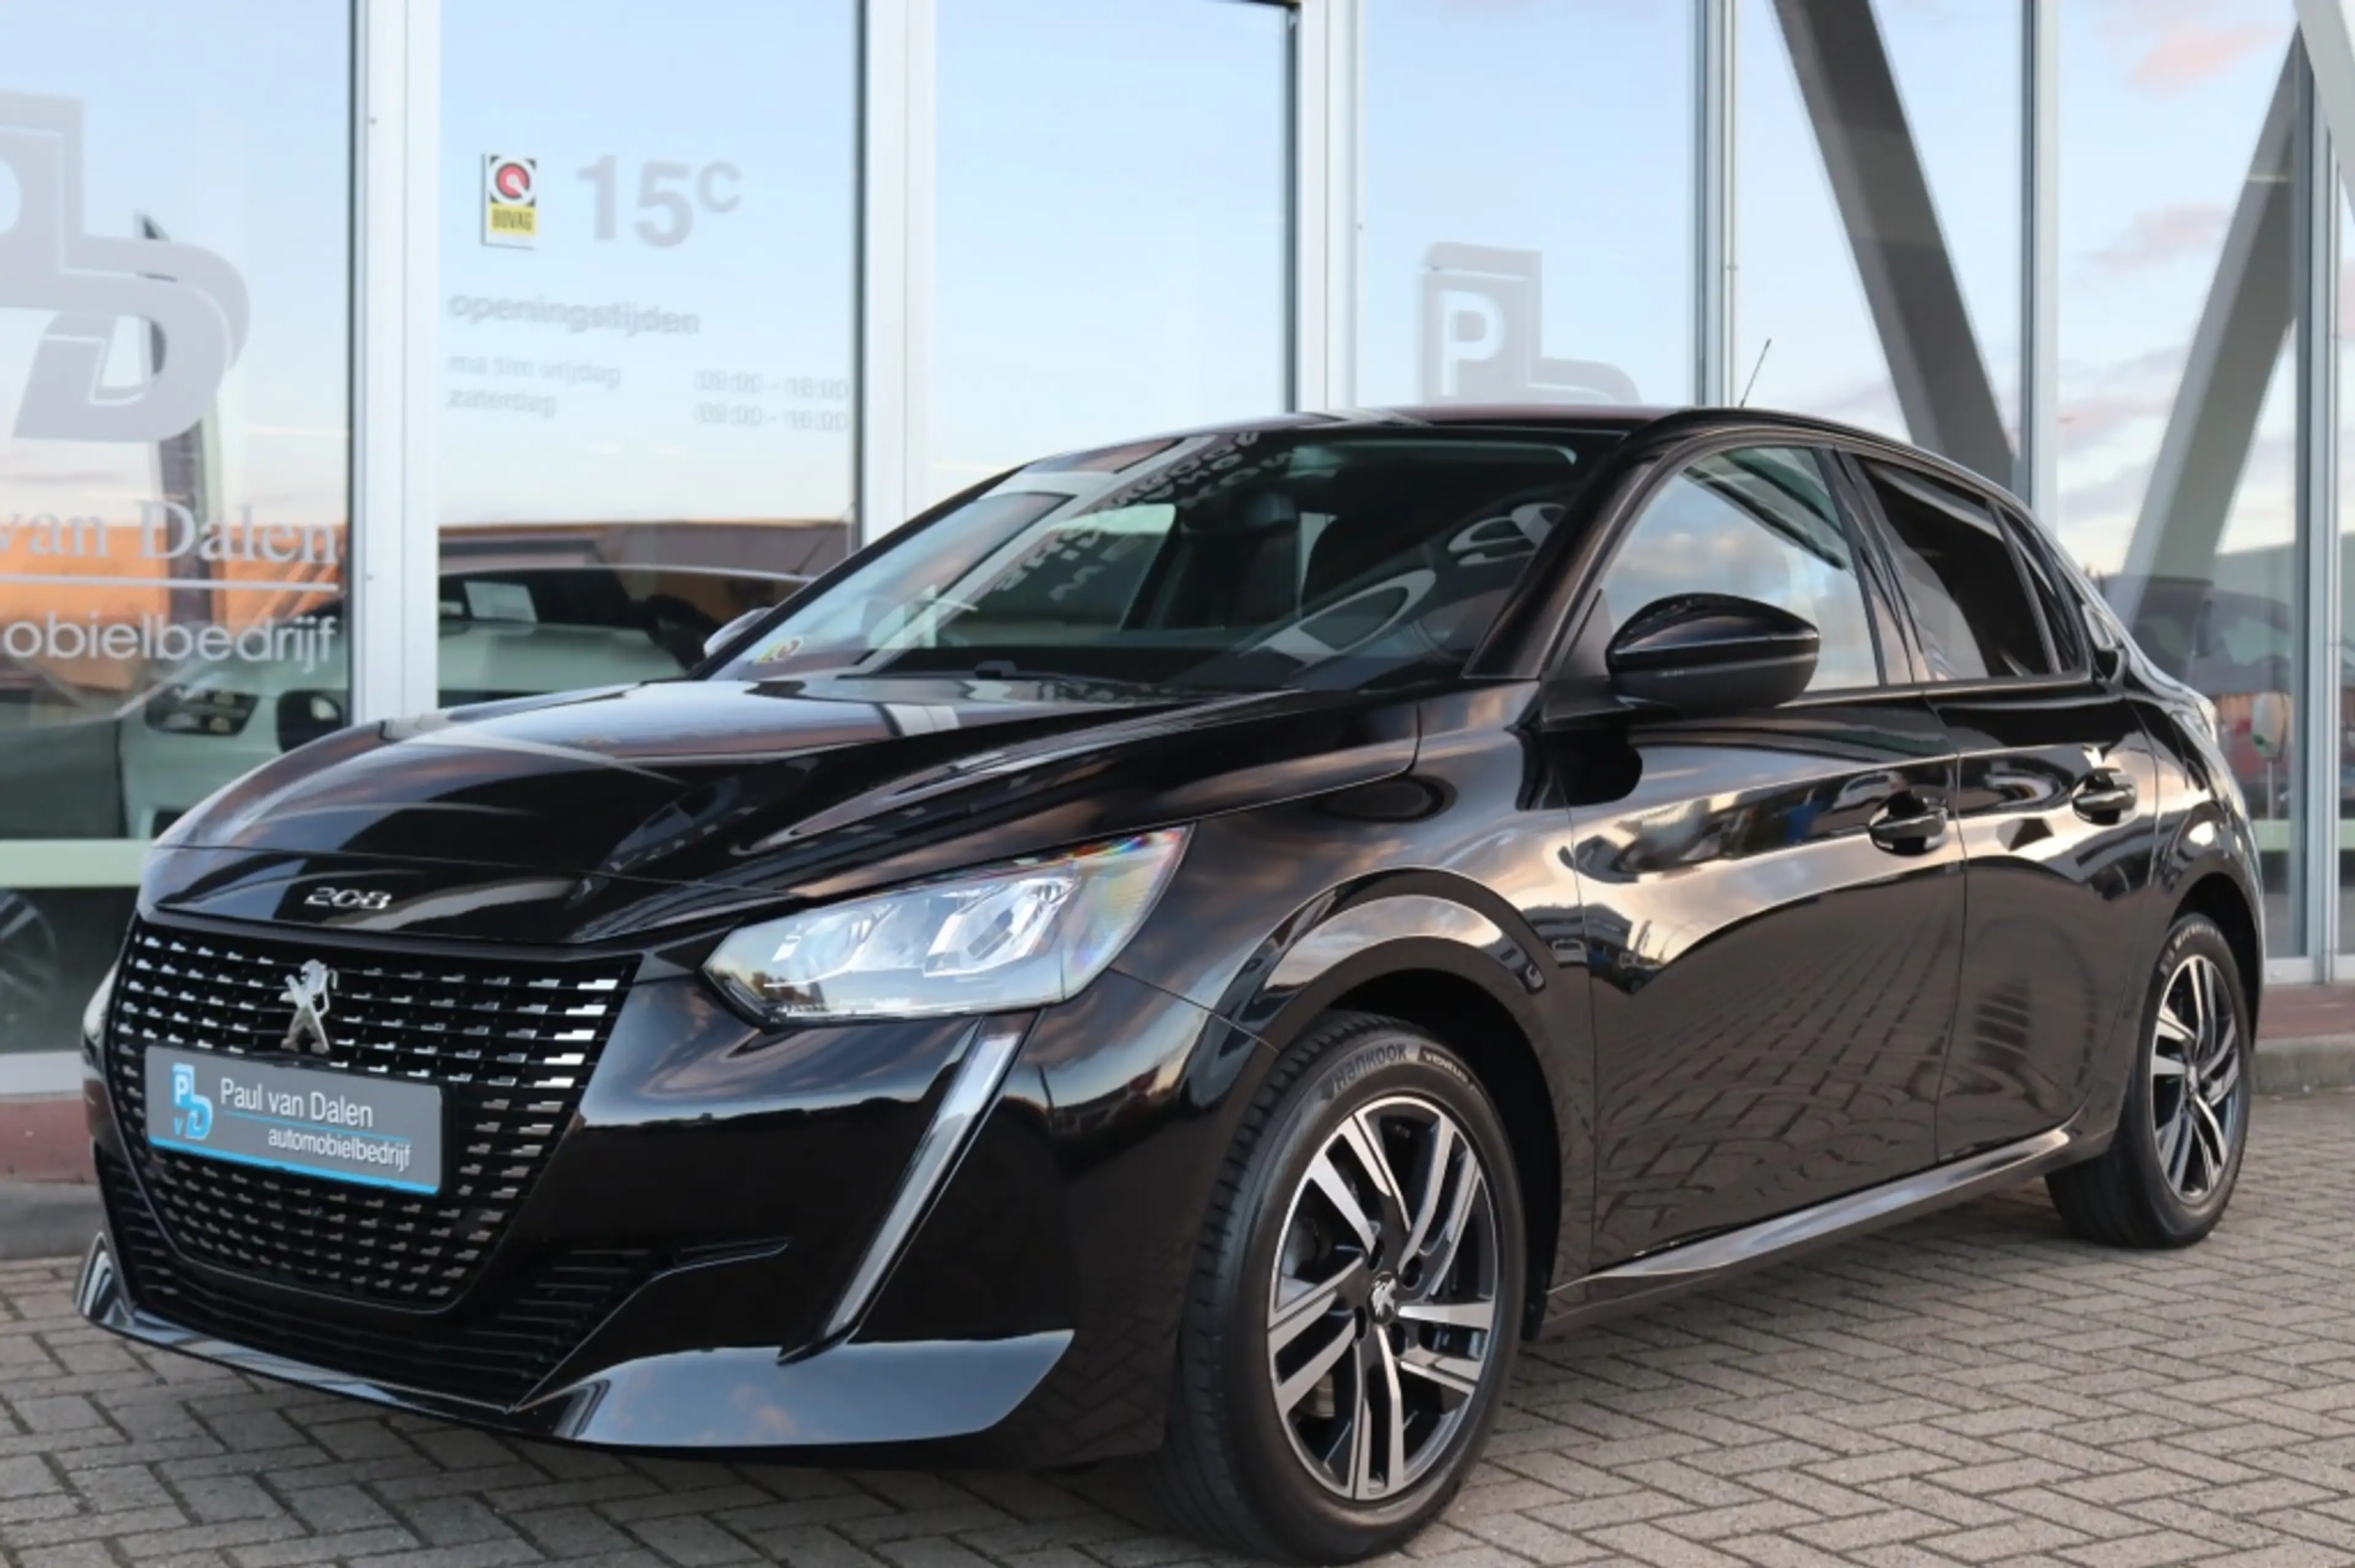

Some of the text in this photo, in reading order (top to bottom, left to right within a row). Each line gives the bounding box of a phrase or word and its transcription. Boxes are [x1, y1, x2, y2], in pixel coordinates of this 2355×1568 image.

[448, 294, 700, 337] openingstijden
[446, 389, 557, 418] zaterdag
[140, 499, 340, 564] Dalen
[304, 887, 392, 909] 208
[220, 1077, 373, 1128] Paul van Dalen
[267, 1128, 411, 1172] automobielbedrijf
